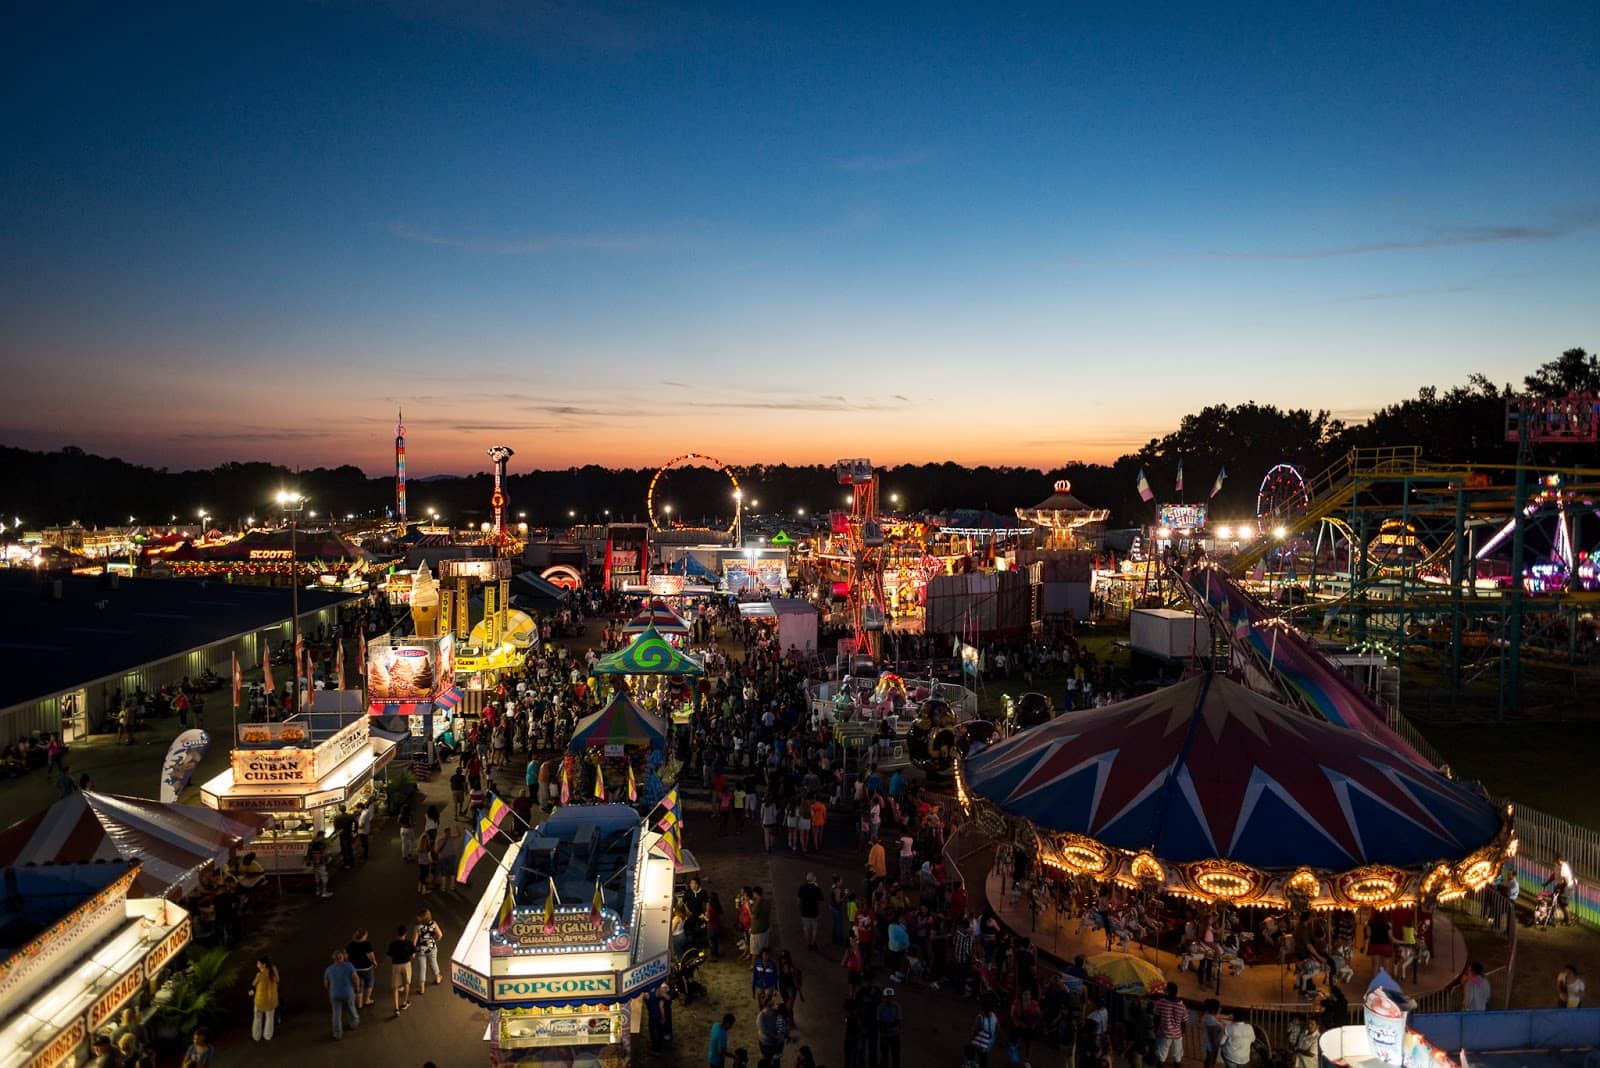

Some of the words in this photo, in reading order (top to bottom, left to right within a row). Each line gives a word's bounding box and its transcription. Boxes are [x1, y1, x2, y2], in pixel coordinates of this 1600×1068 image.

[1168, 507, 1198, 520] SUPER
[249, 762, 298, 771] CUBAN
[244, 771, 304, 780] CUISINE
[229, 800, 295, 808] EMPANADAS
[512, 923, 560, 936] COTTN
[147, 943, 168, 973] CORN
[169, 922, 189, 956] DOGS
[520, 935, 561, 944] CARAMEL
[564, 934, 597, 942] APPLES
[457, 967, 482, 985] COLD
[624, 964, 667, 989] DRINKS
[631, 959, 661, 978] COLD
[453, 973, 487, 997] DRINKS
[498, 978, 612, 995] POPCORN
[91, 967, 141, 1028] SAUSAGE
